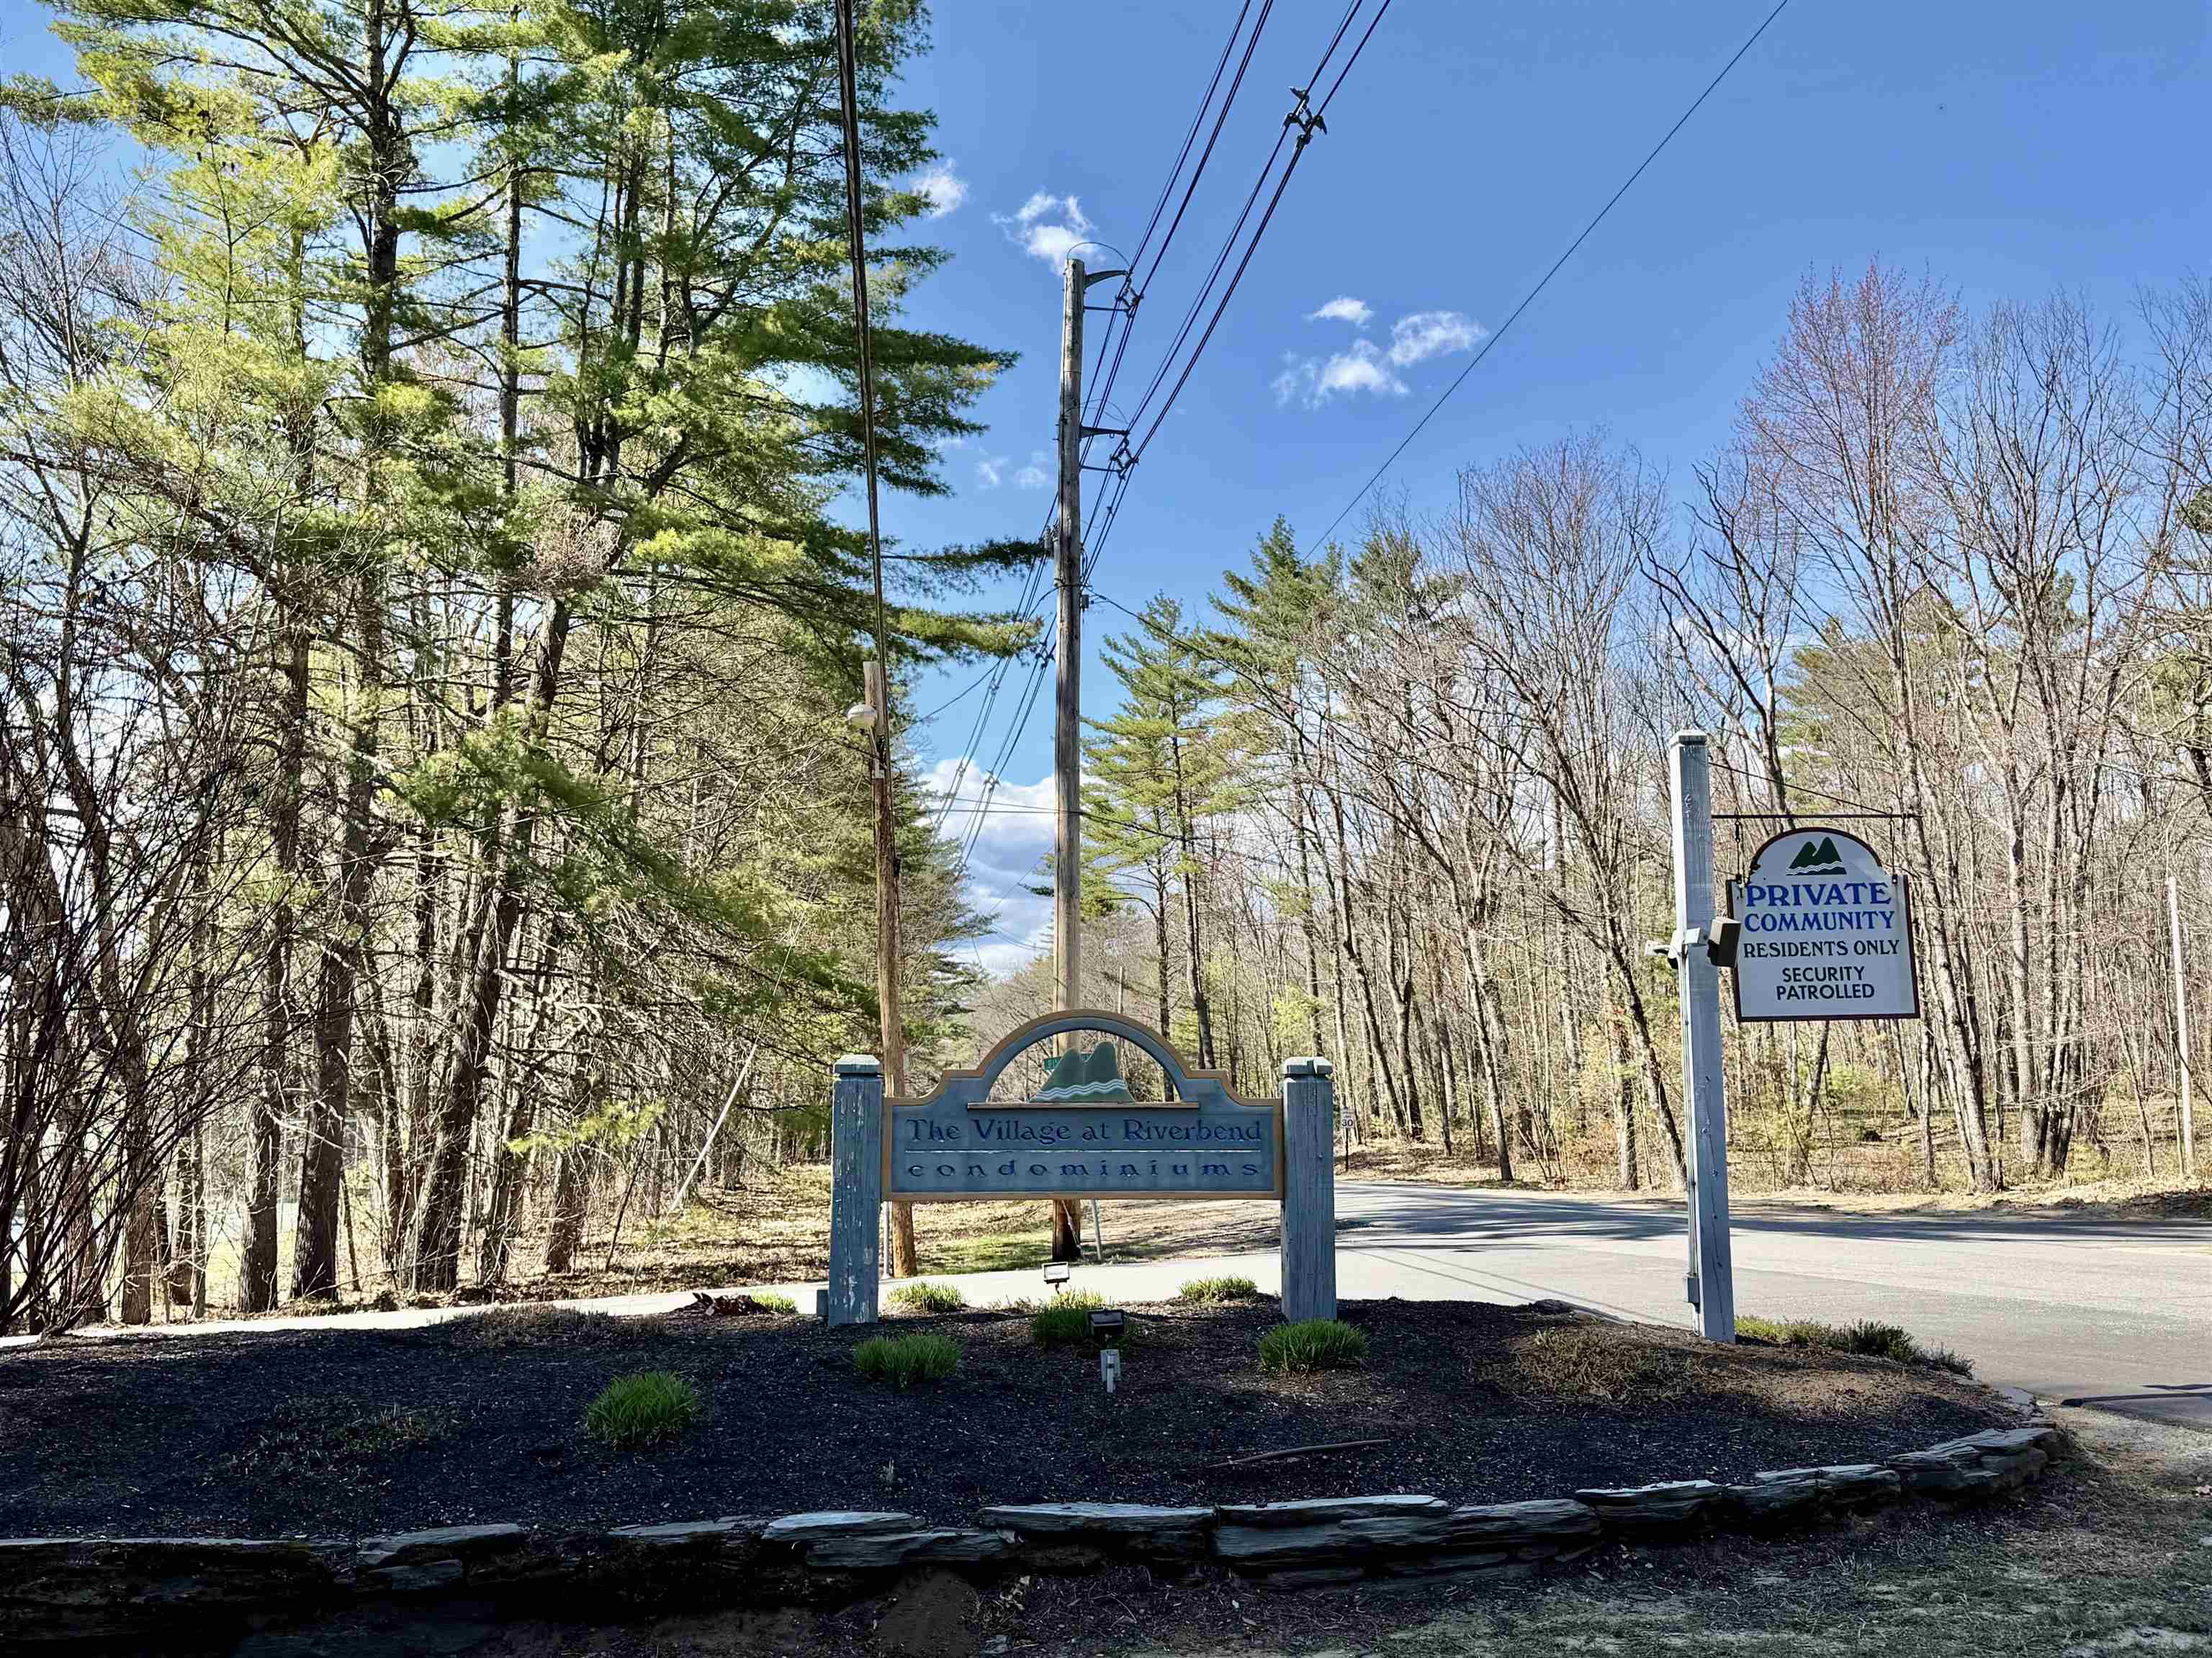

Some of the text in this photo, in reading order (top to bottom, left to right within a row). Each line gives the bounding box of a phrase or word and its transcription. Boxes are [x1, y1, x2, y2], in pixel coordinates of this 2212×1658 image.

[1745, 882, 1892, 907] PRIVATE
[1744, 910, 1896, 932] COMMUNITY
[1743, 939, 1900, 958] RESIDENTS ONLY
[1782, 965, 1865, 983] SECURITY
[1776, 983, 1875, 1001] PATROLLED
[907, 1118, 1262, 1145] The Village at Riverbend
[1341, 1118, 1354, 1127] 30
[908, 1159, 1259, 1177] condominiums
